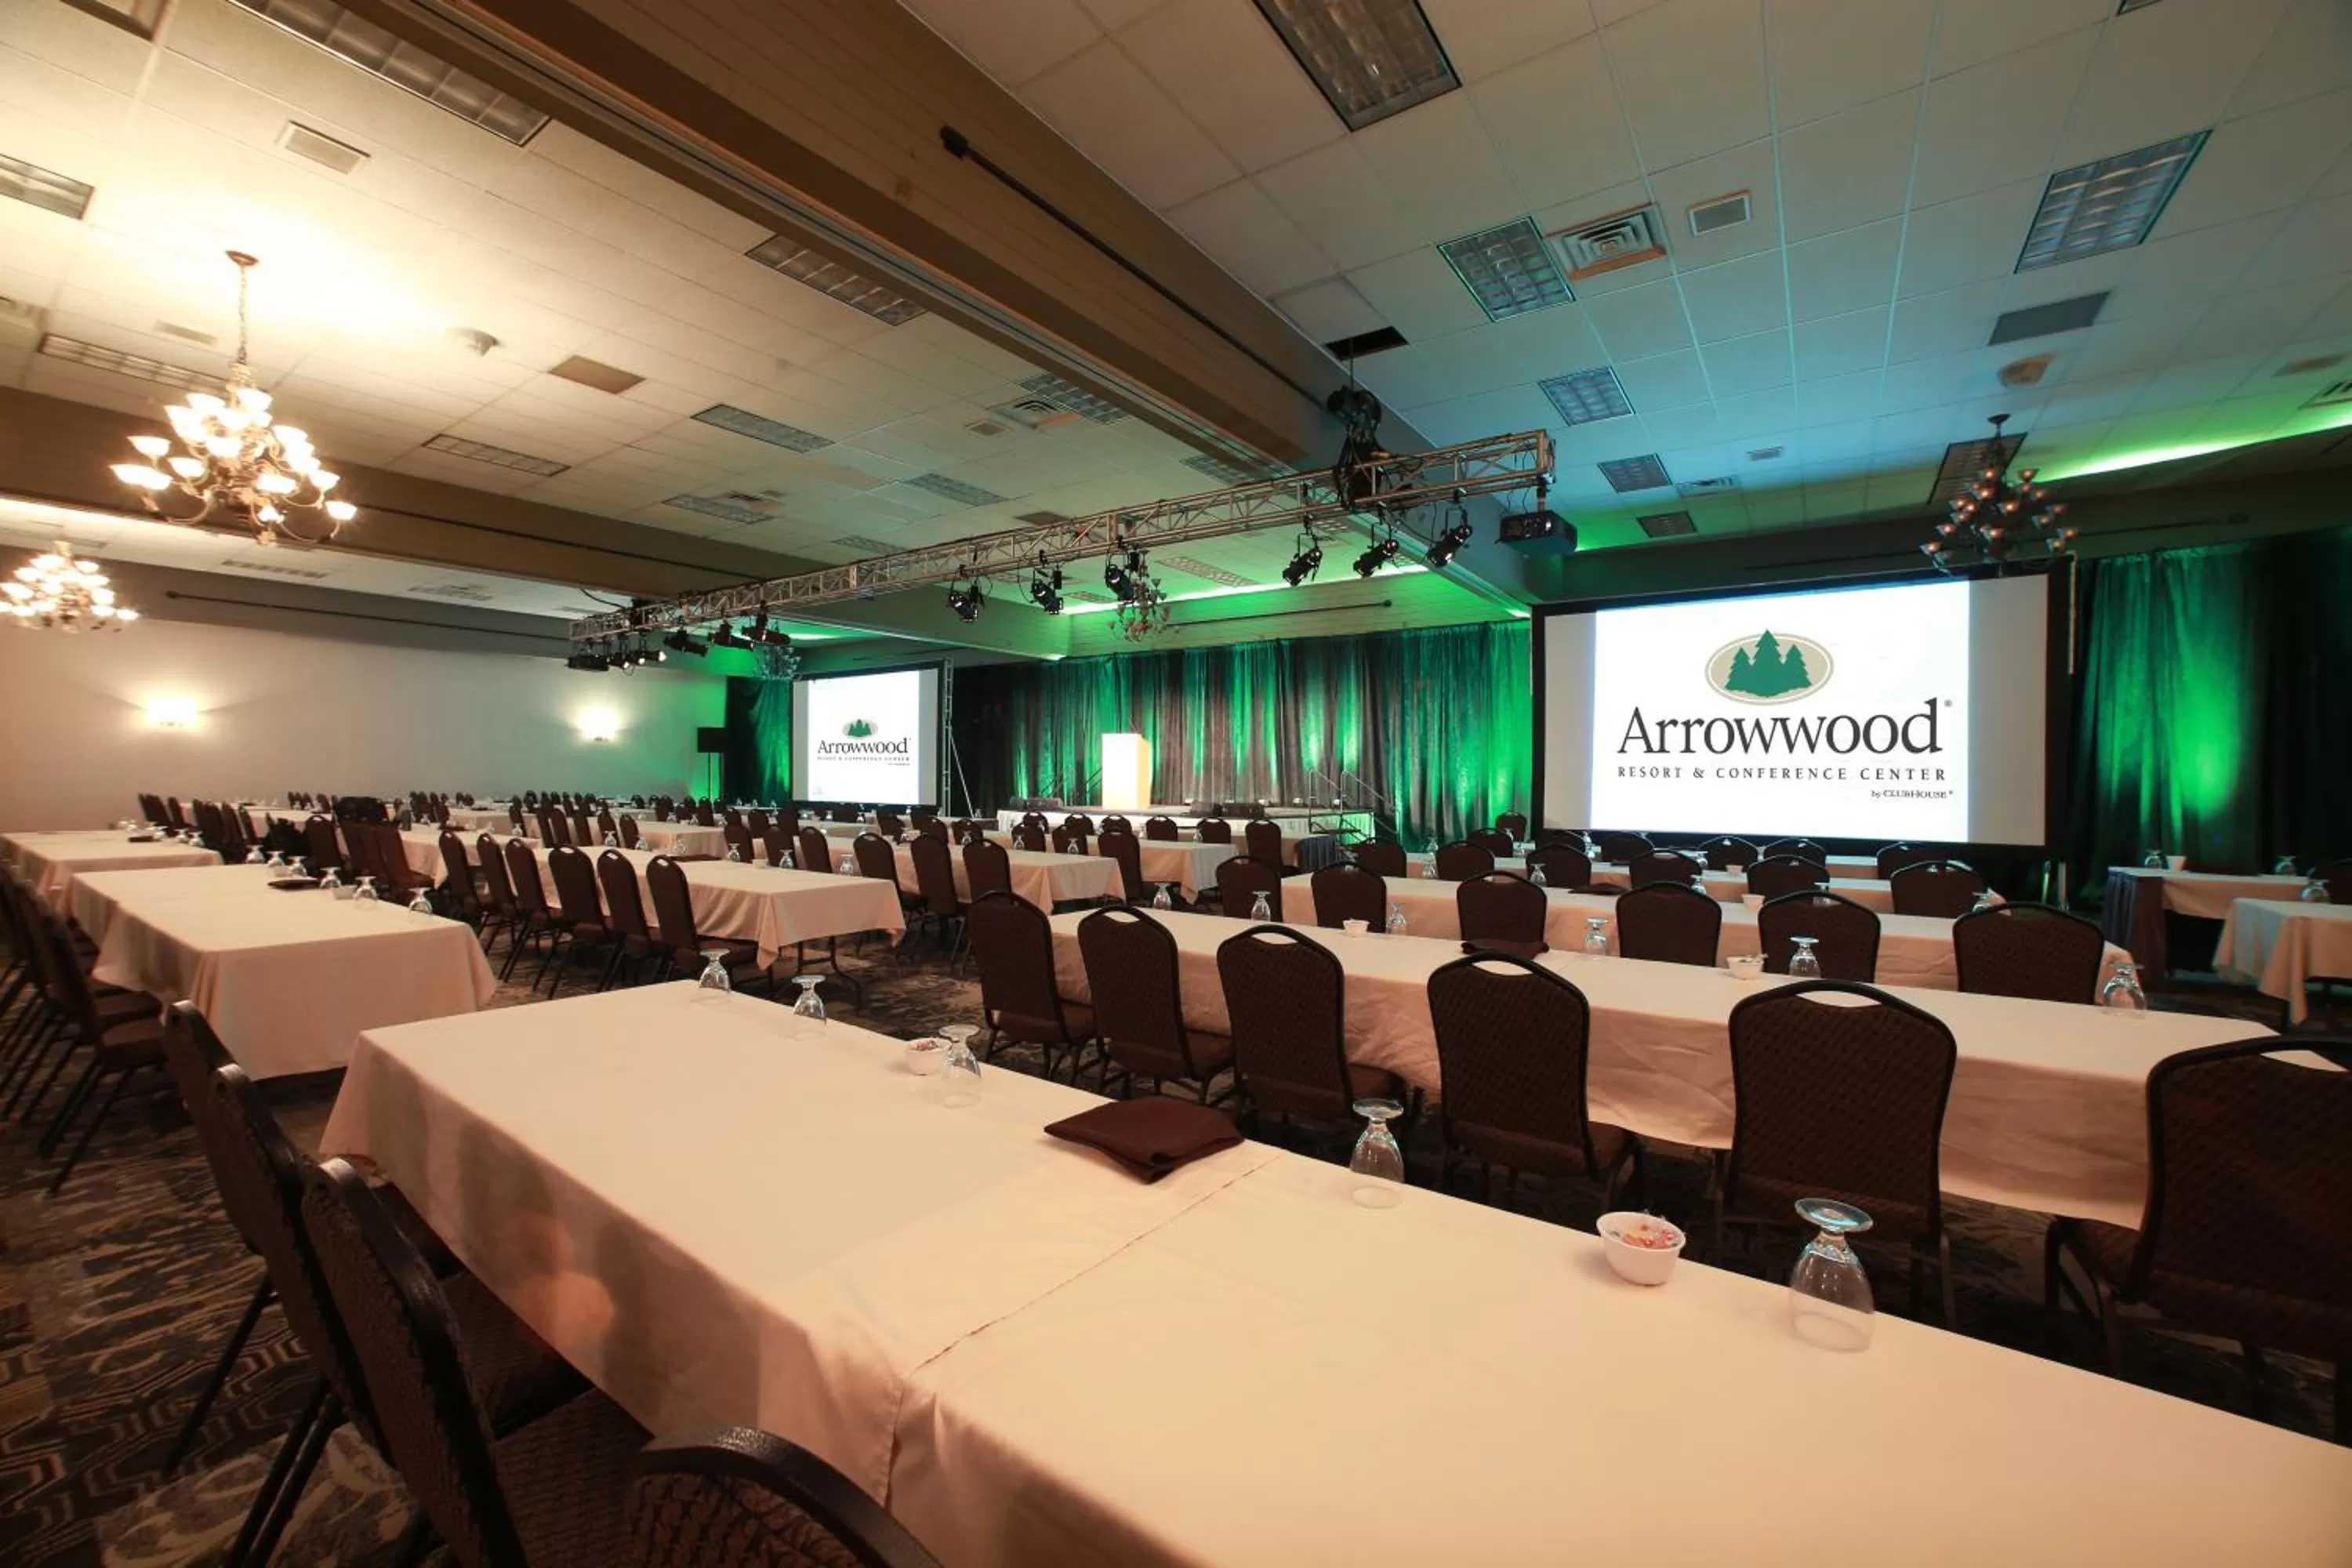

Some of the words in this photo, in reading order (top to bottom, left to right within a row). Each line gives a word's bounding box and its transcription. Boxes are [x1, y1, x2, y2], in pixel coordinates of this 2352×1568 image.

[1617, 696, 1944, 754] Arrowwood
[817, 737, 909, 754] Arrowwood
[1617, 766, 1682, 779] RESORT
[1693, 767, 1705, 779] &
[1715, 768, 1847, 780] CONFERENCE
[1859, 768, 1945, 781] CENTER
[1871, 789, 1882, 798] by
